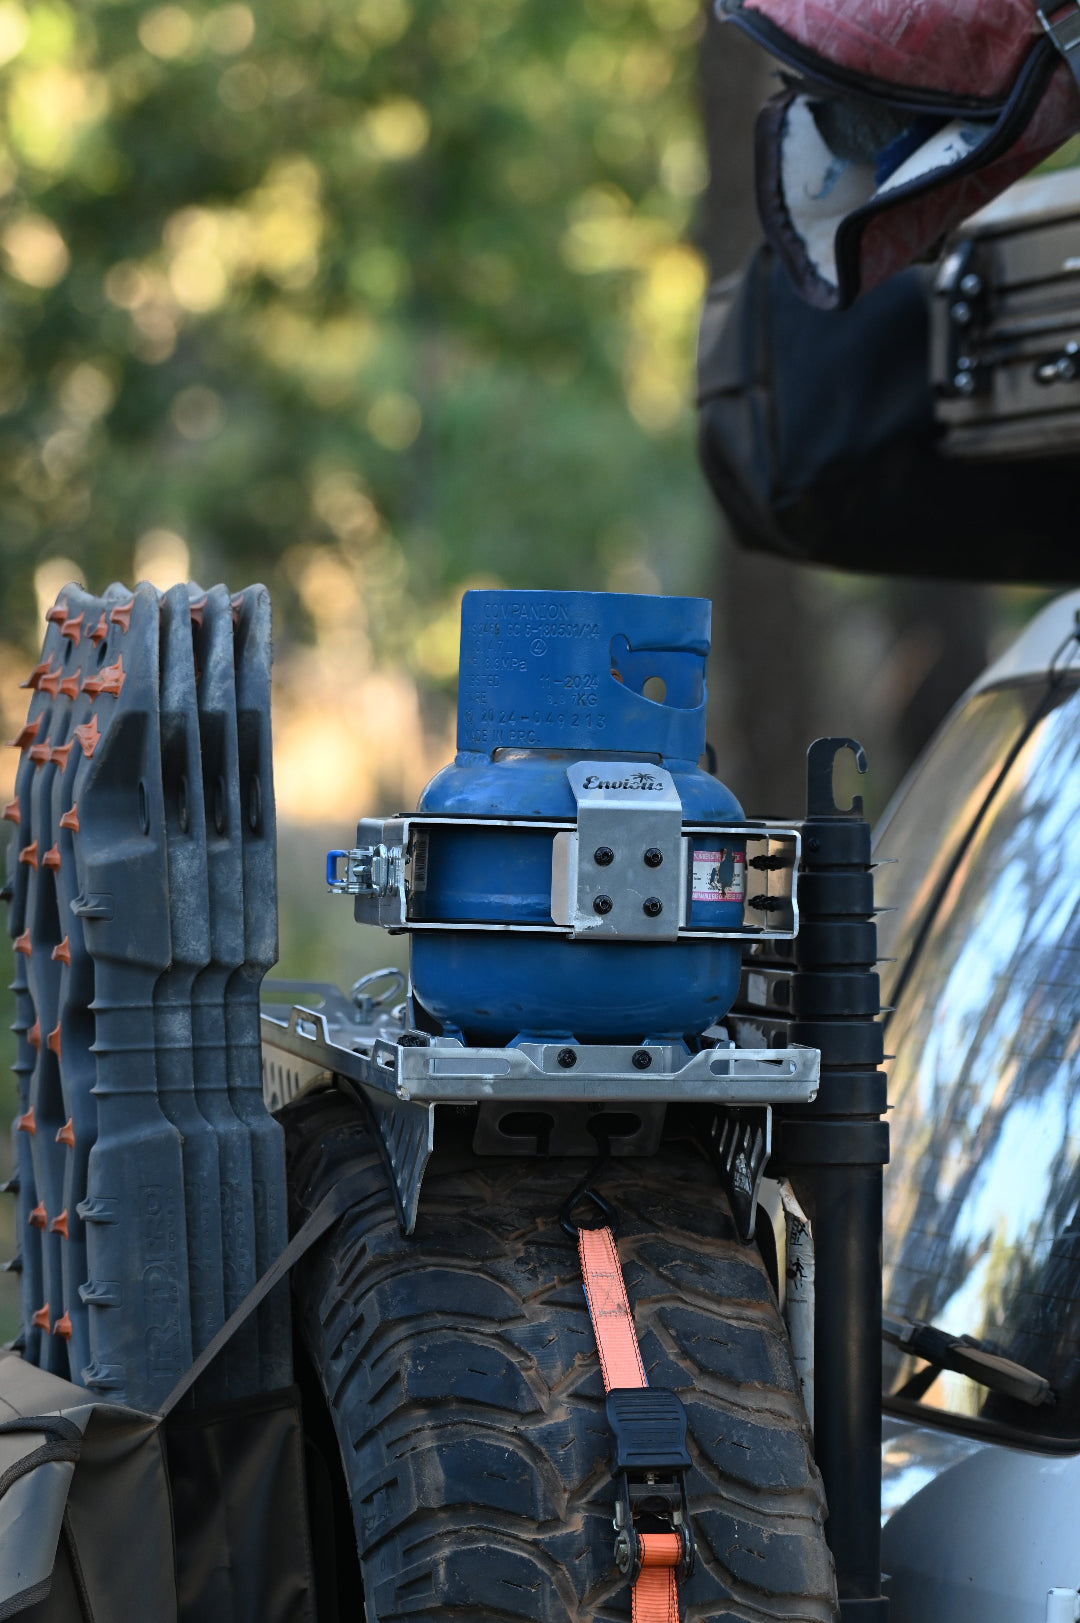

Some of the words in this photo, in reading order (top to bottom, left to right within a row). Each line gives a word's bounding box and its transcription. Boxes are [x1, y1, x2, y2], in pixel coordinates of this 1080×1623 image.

[482, 602, 570, 620] COMPANION
[539, 673, 599, 690] 11-2024
[582, 774, 665, 791] Envious
